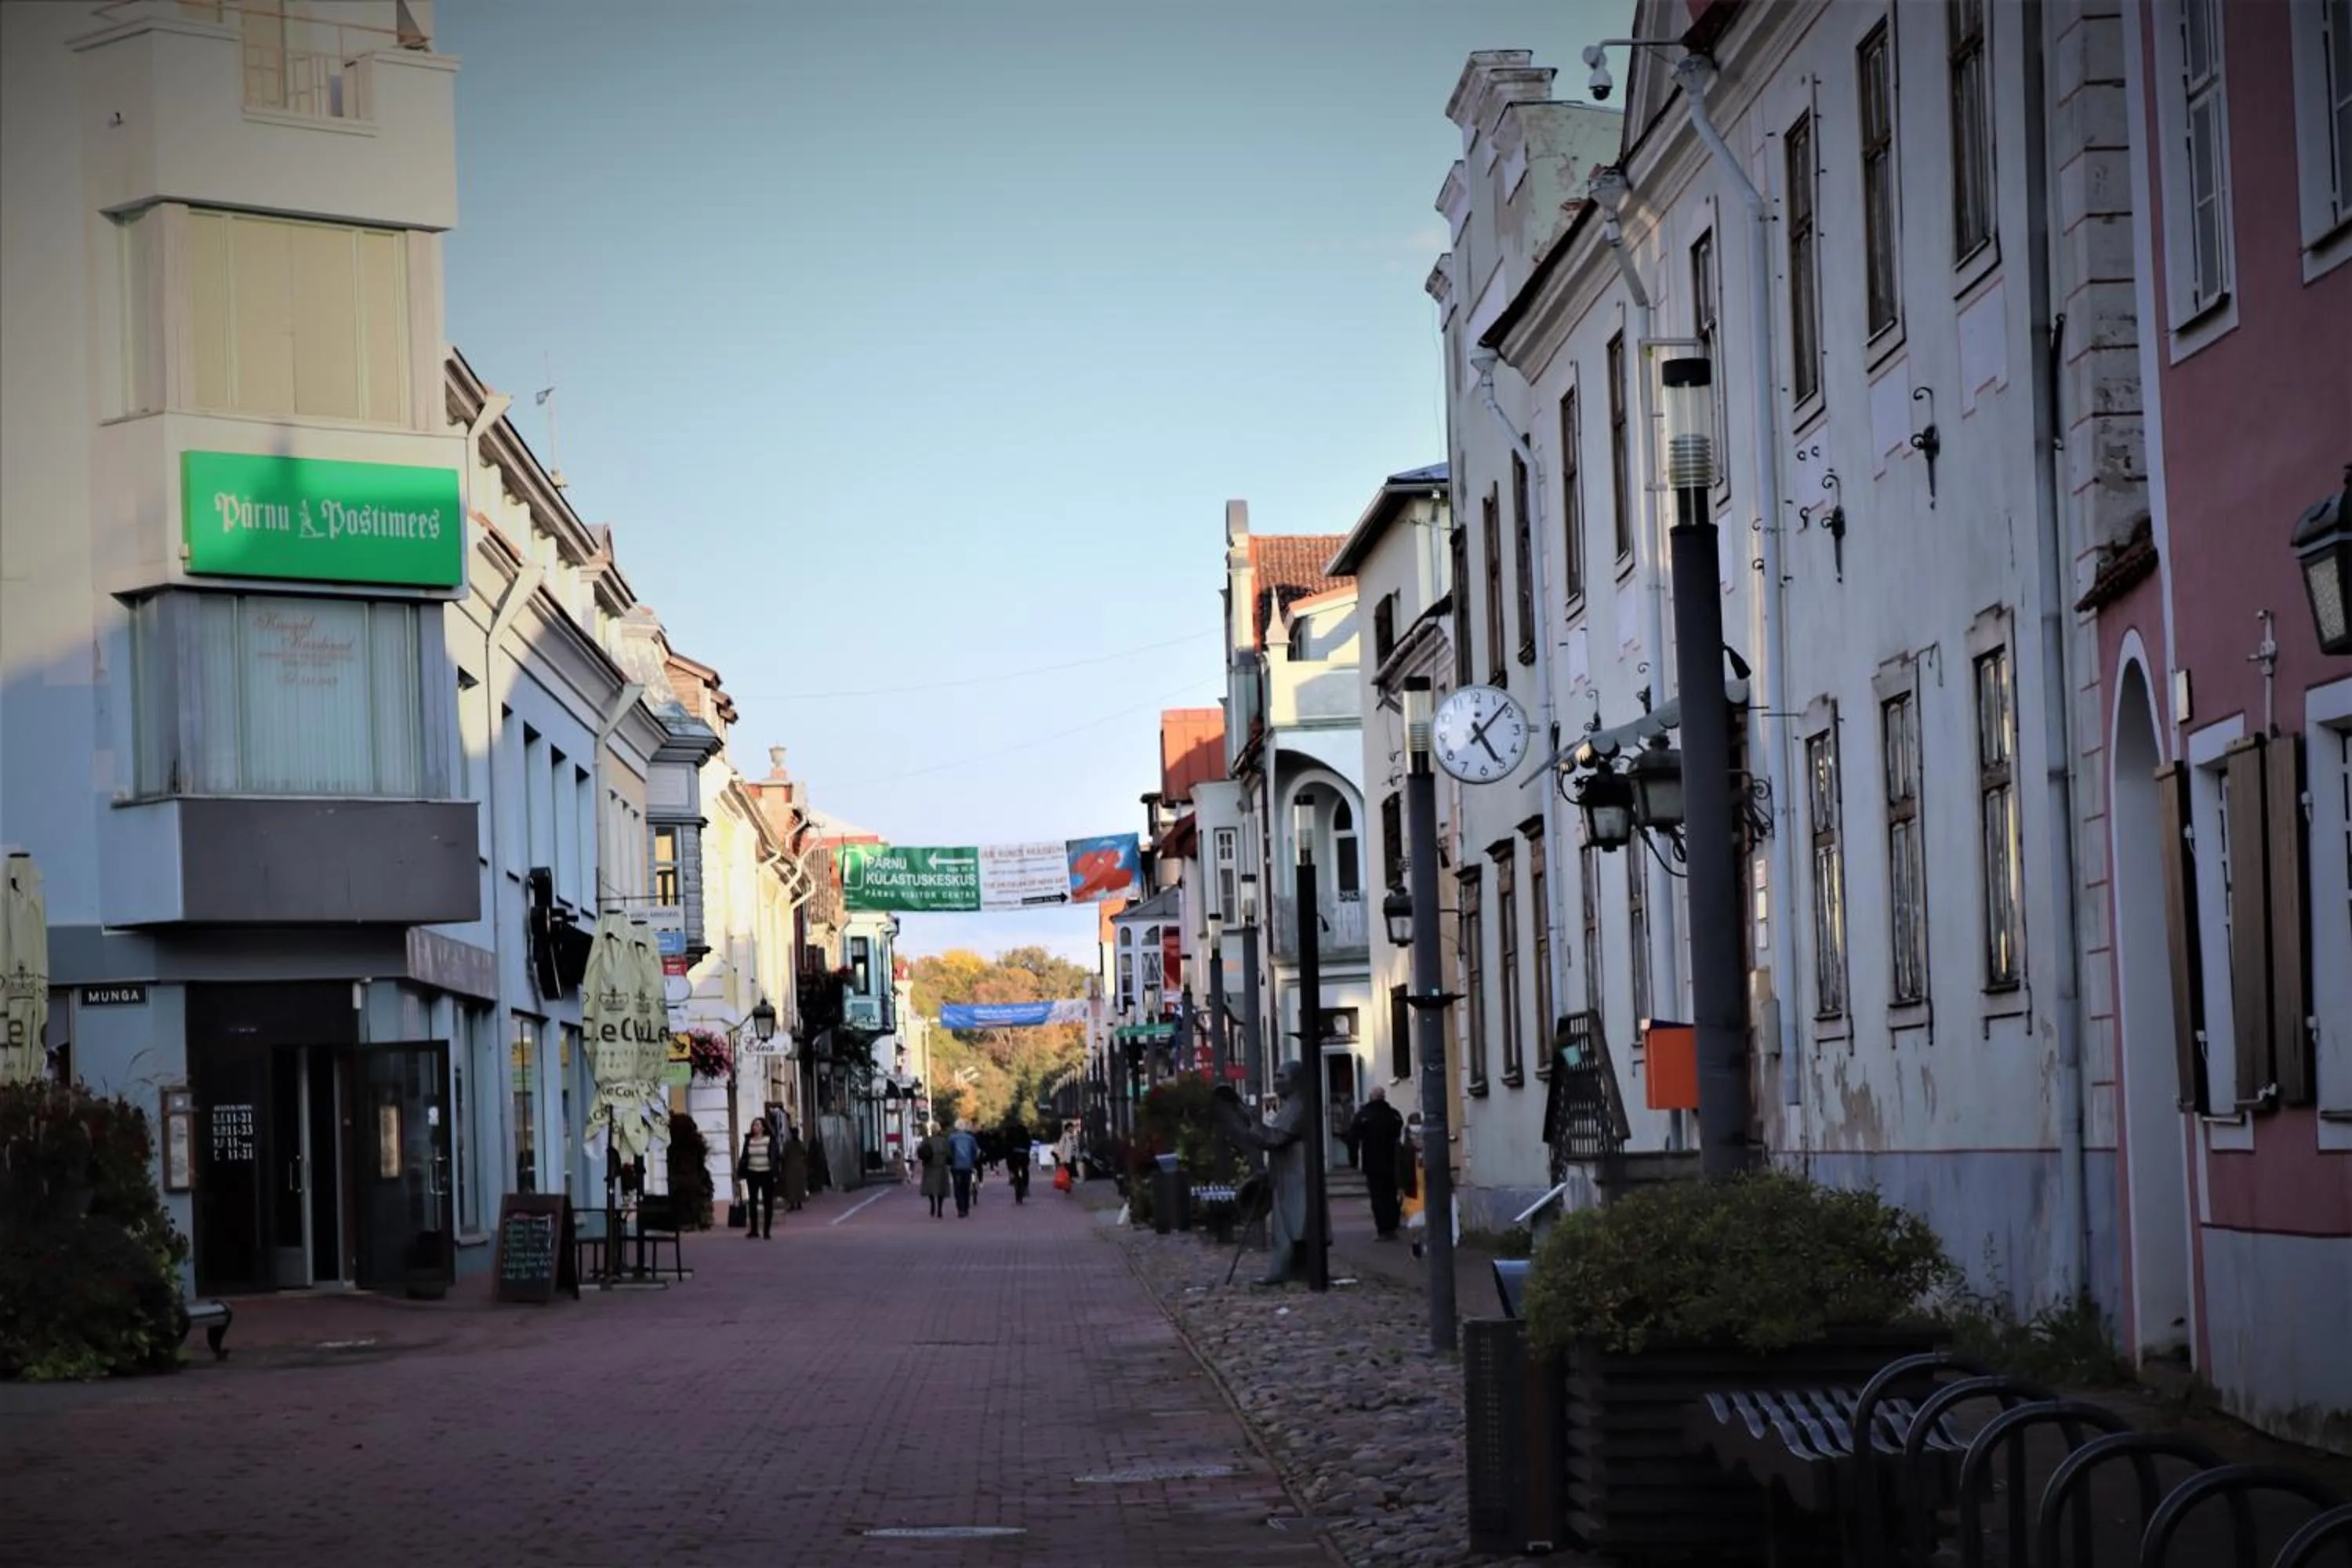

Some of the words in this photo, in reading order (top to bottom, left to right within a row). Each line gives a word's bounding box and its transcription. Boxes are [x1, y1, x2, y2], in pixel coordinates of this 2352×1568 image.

[321, 499, 440, 539] Postimees
[1512, 724, 1520, 735] 3
[1510, 742, 1518, 755] 4
[1446, 750, 1454, 761] 8
[1460, 761, 1468, 775] 7
[1479, 765, 1488, 776] 6
[89, 990, 139, 1003] MUNGA
